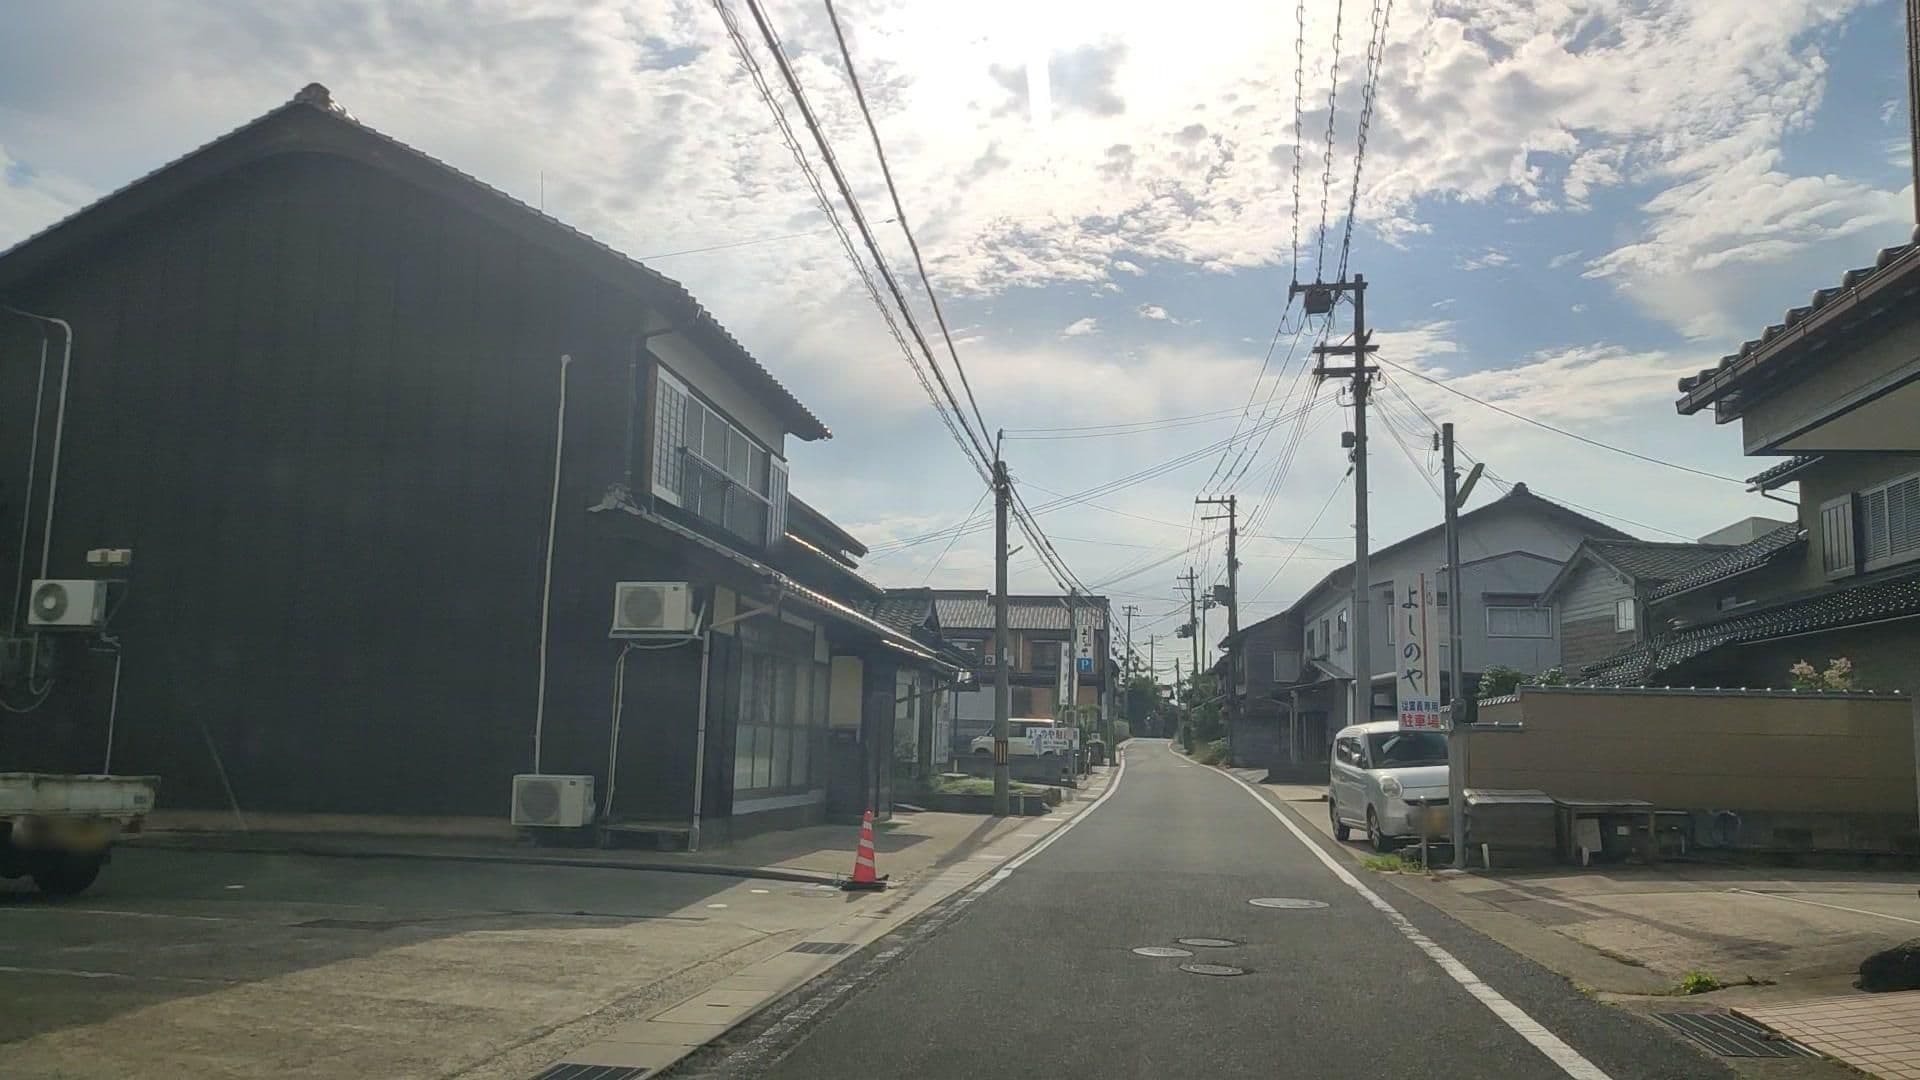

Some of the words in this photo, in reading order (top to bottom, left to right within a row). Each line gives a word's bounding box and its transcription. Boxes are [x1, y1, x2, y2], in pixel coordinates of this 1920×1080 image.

[1401, 584, 1422, 692] よしのや
[1402, 713, 1440, 728] 駐車場
